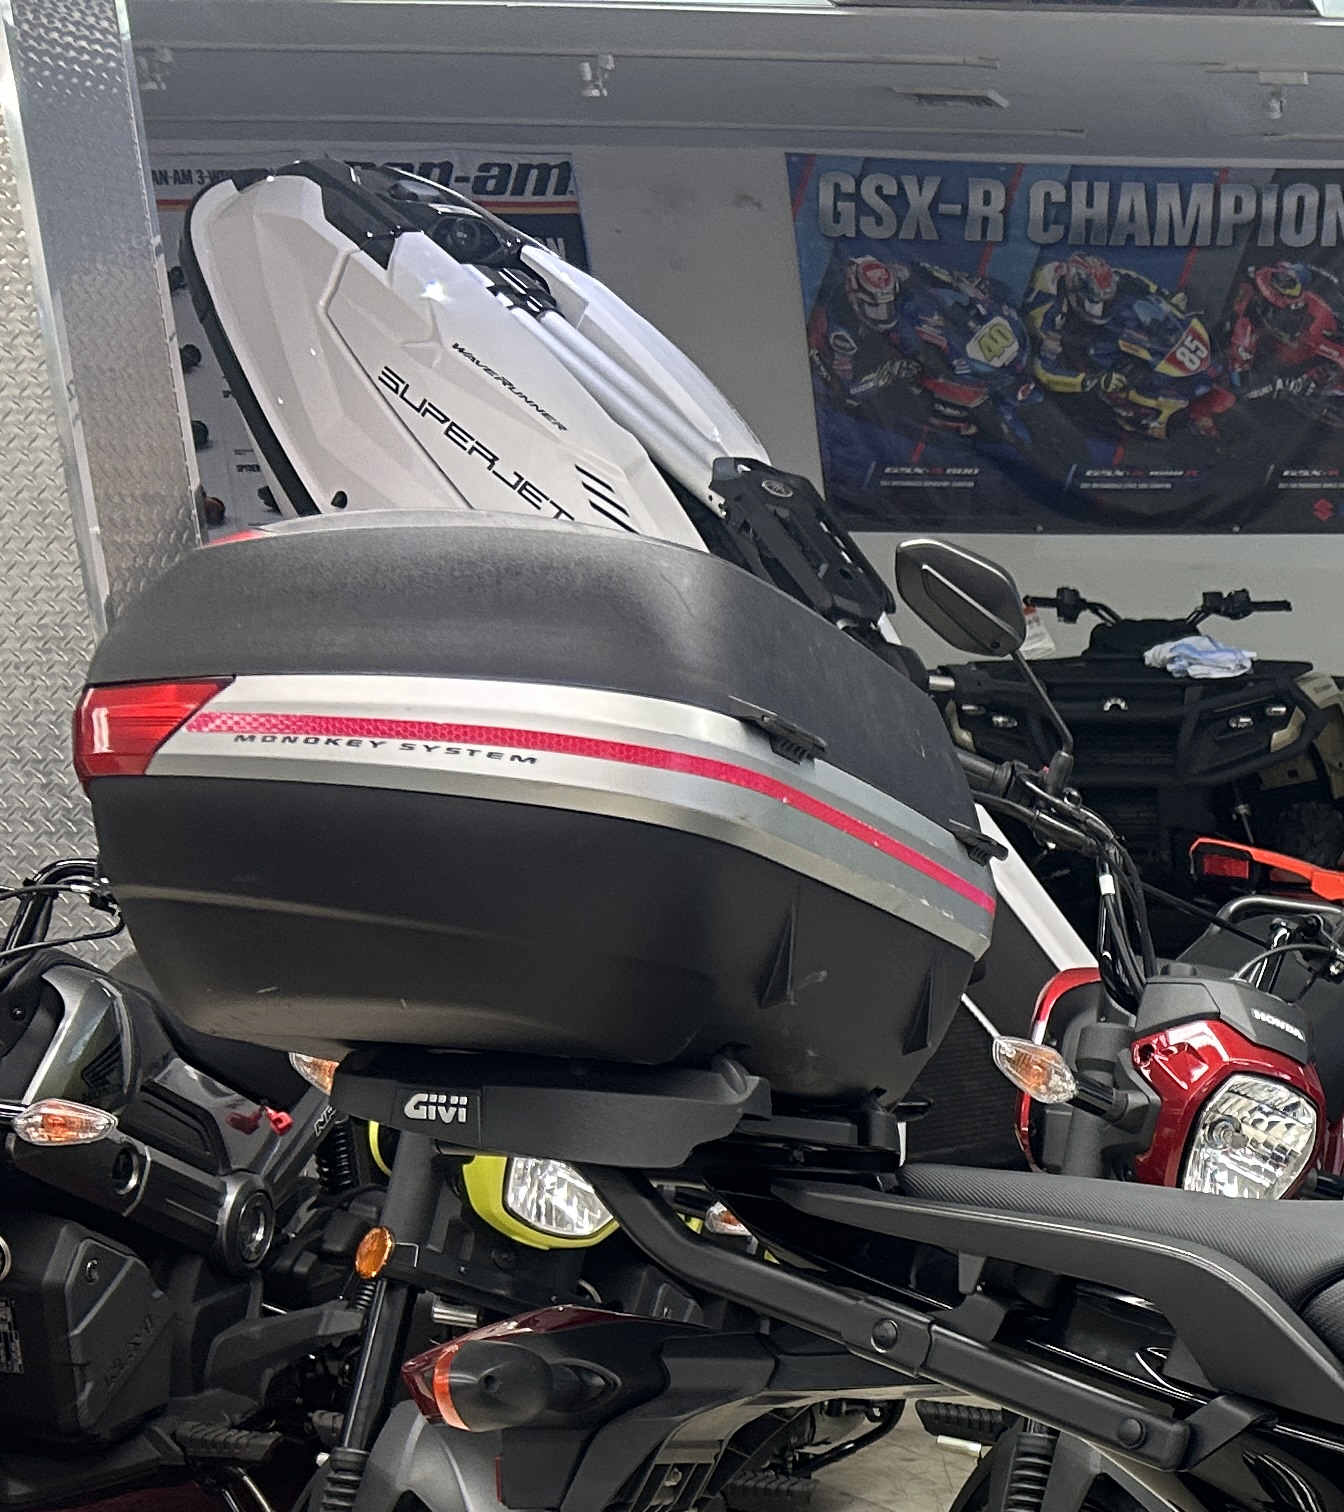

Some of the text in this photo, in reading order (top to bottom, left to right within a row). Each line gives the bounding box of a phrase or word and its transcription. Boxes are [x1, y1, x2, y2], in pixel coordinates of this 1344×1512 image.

[345, 160, 570, 196] n-am
[817, 171, 1007, 243] GSX-R
[1175, 335, 1209, 372] 85
[452, 342, 568, 432] WAVERUNNER
[378, 366, 575, 520] SUPERJET
[234, 734, 538, 765] MONOKEY SYSTEM
[1252, 1008, 1306, 1042] HONDA
[404, 1092, 468, 1123] GIVI
